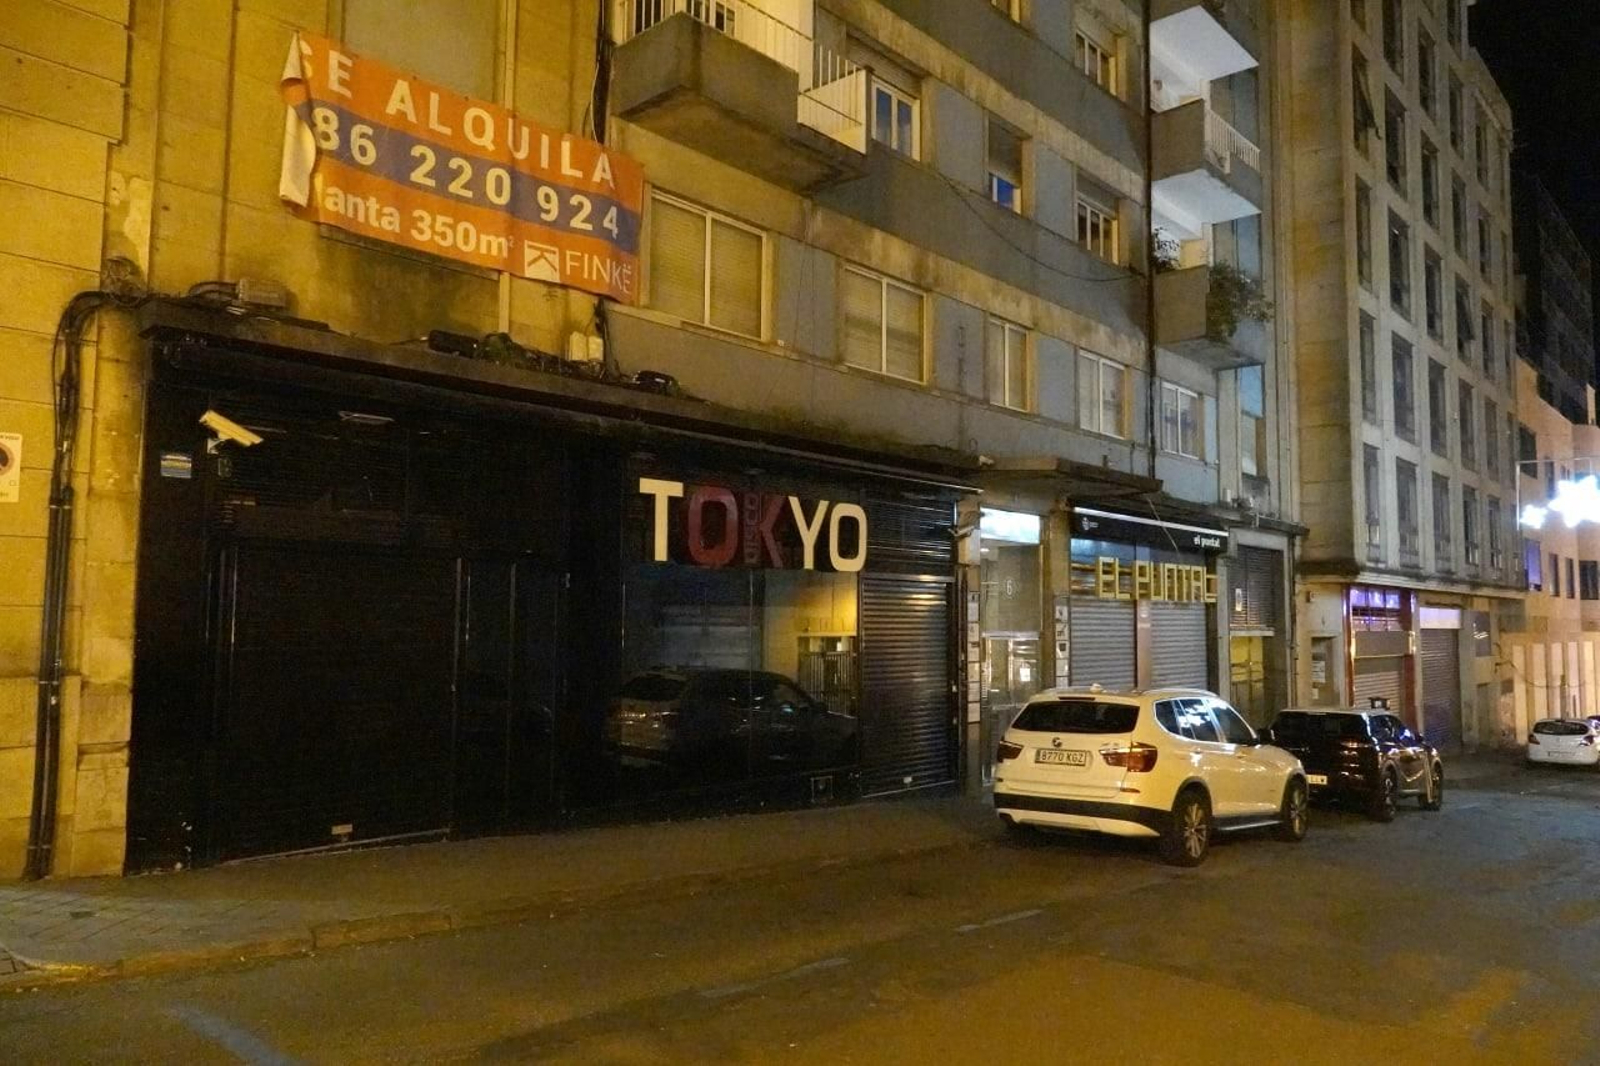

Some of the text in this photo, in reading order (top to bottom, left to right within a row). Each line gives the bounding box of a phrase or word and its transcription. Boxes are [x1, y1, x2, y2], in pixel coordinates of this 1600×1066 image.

[385, 79, 615, 189] ALQUILA
[409, 145, 512, 206] 220
[537, 186, 620, 240] 924
[639, 477, 869, 572] TOKYO
[1097, 556, 1130, 600] EL
[1041, 751, 1084, 763] 8770 KGZ
